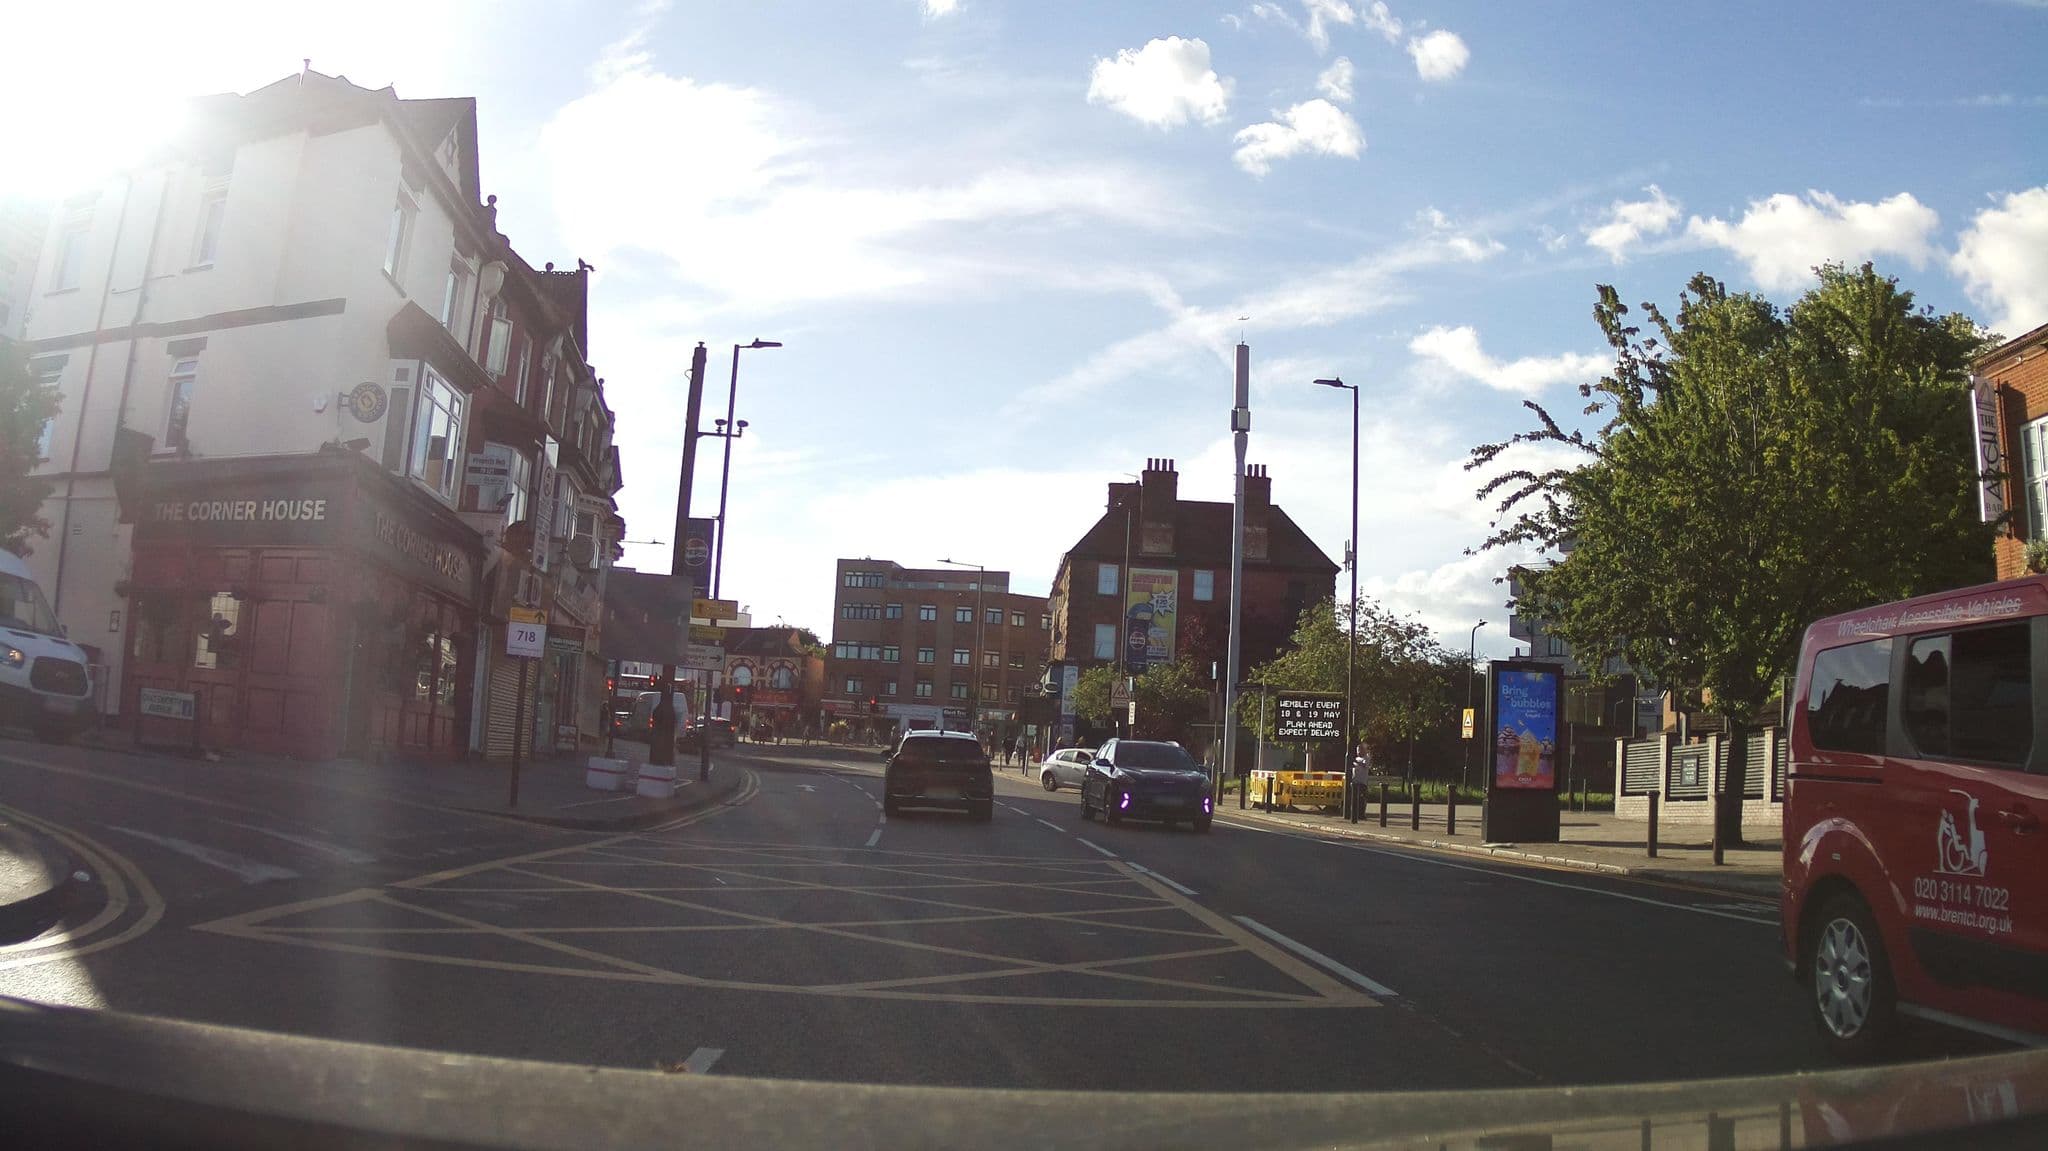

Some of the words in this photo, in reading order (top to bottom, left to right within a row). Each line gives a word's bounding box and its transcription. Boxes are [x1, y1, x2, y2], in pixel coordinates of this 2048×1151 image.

[1980, 414, 1996, 428] THE
[1982, 430, 2002, 500] ARCH
[156, 503, 183, 521] THE
[188, 500, 257, 521] CORNER
[261, 499, 326, 521] HOUSE
[1838, 615, 1896, 637] Wheelchair
[1899, 605, 1963, 627] Accessible
[1968, 596, 2022, 617] Vehicles
[518, 630, 536, 643] 718
[1502, 685, 1528, 697] Bring
[1511, 698, 1552, 709] bubbles
[1281, 710, 1291, 718] 18
[1323, 711, 1340, 719] MAY
[1915, 878, 1937, 900] 020
[1941, 881, 1971, 904] 3114
[1976, 886, 2008, 911] 7022
[1915, 904, 2013, 934] www.brentct.org.uk
